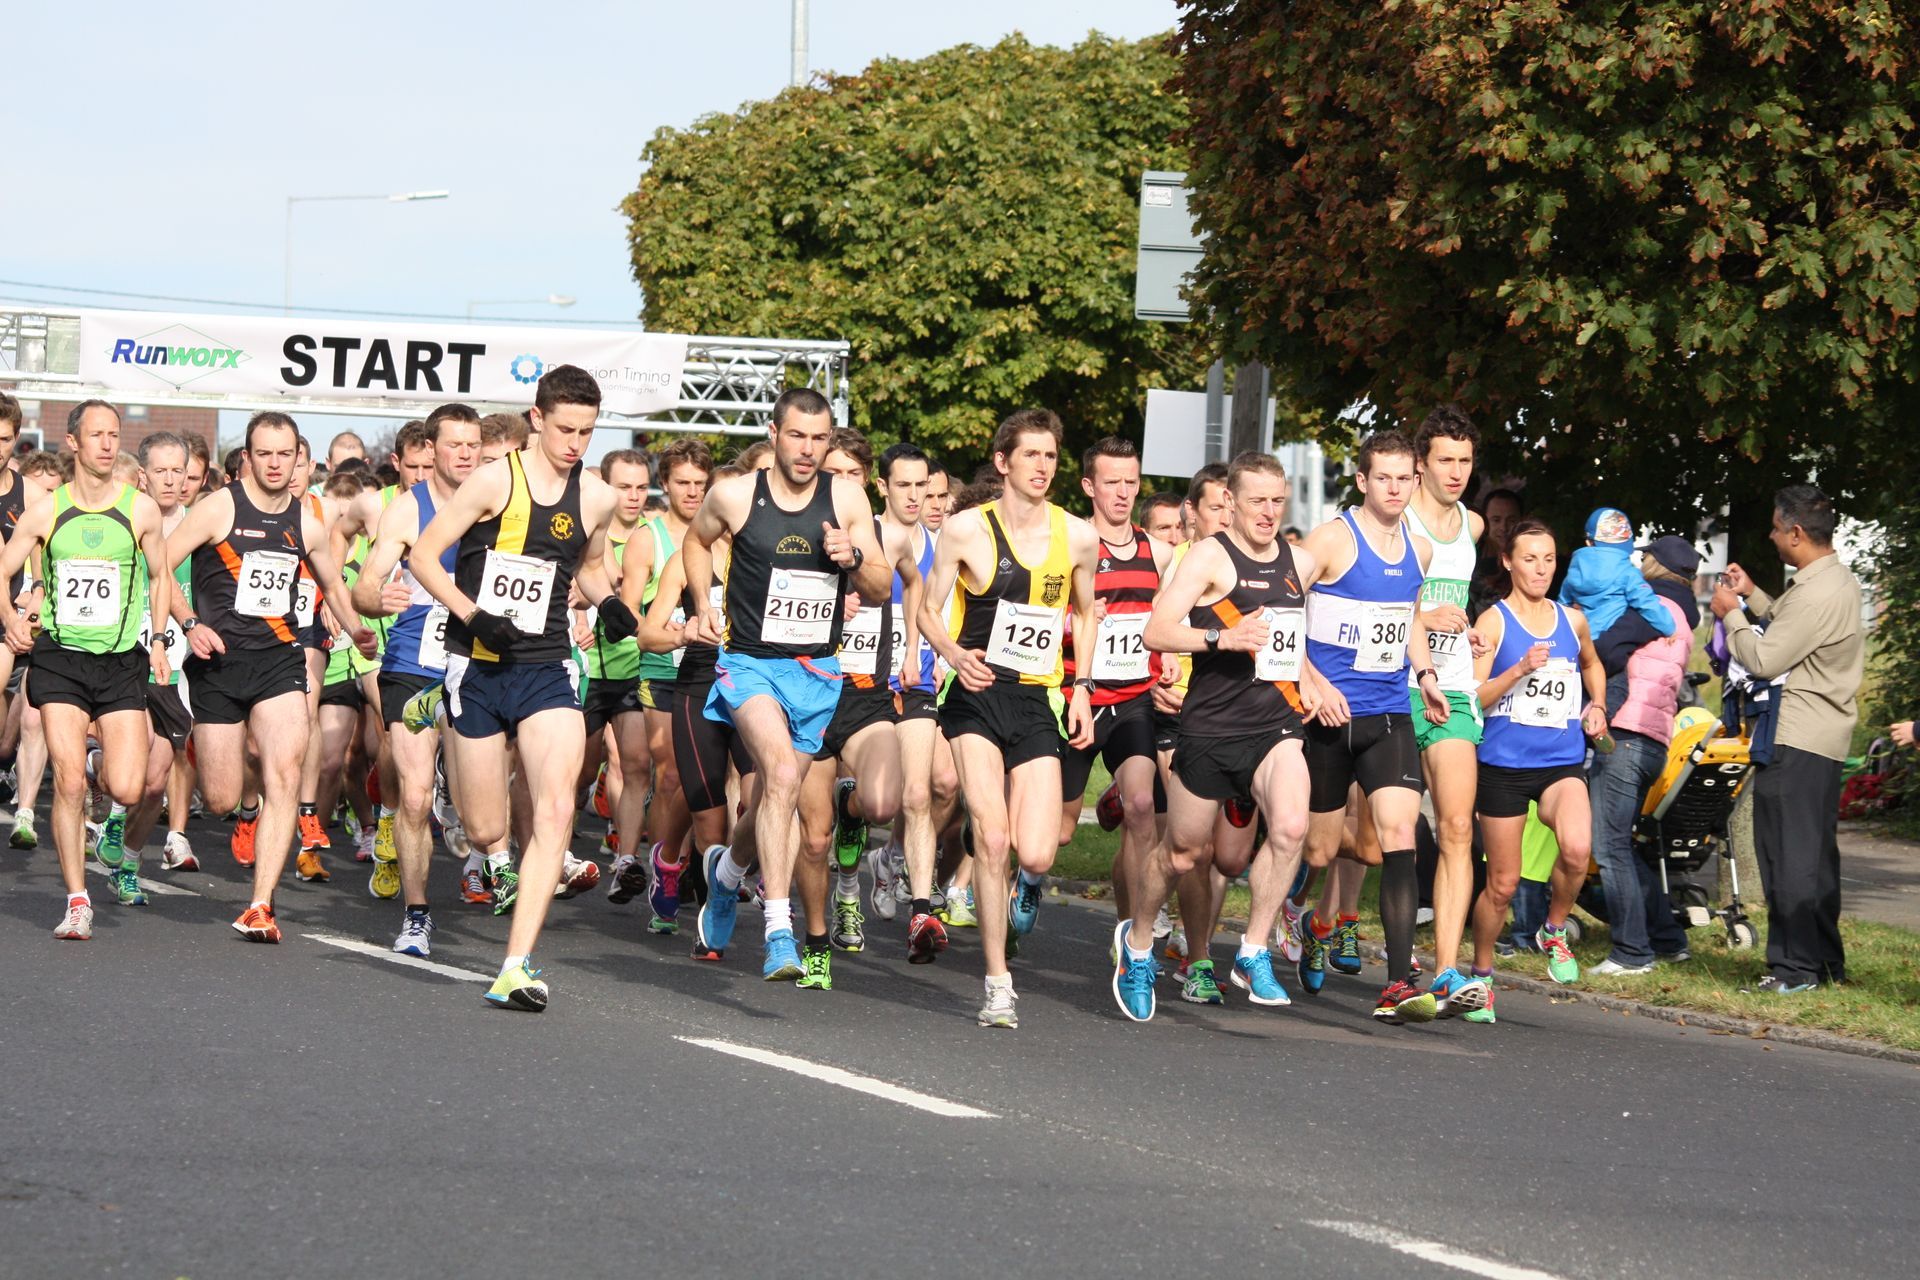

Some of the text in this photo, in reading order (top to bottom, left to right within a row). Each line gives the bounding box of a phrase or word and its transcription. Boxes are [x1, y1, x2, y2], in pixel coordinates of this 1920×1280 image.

[111, 338, 243, 369] Runworx
[280, 334, 486, 393] START
[547, 364, 671, 386] Psion Timing
[66, 578, 110, 599] 276
[249, 569, 288, 591] 535
[493, 574, 543, 603] 605
[768, 599, 833, 619] 21616
[141, 629, 175, 648] 13
[842, 633, 877, 650] 764
[1005, 623, 1052, 650] 126
[1105, 633, 1142, 654] 112
[1273, 630, 1296, 653] 84
[1371, 622, 1406, 644] 380
[1428, 633, 1457, 652] 677
[1002, 647, 1040, 661] Runworx
[1105, 659, 1137, 667] Runworx
[1525, 678, 1565, 701] 549
